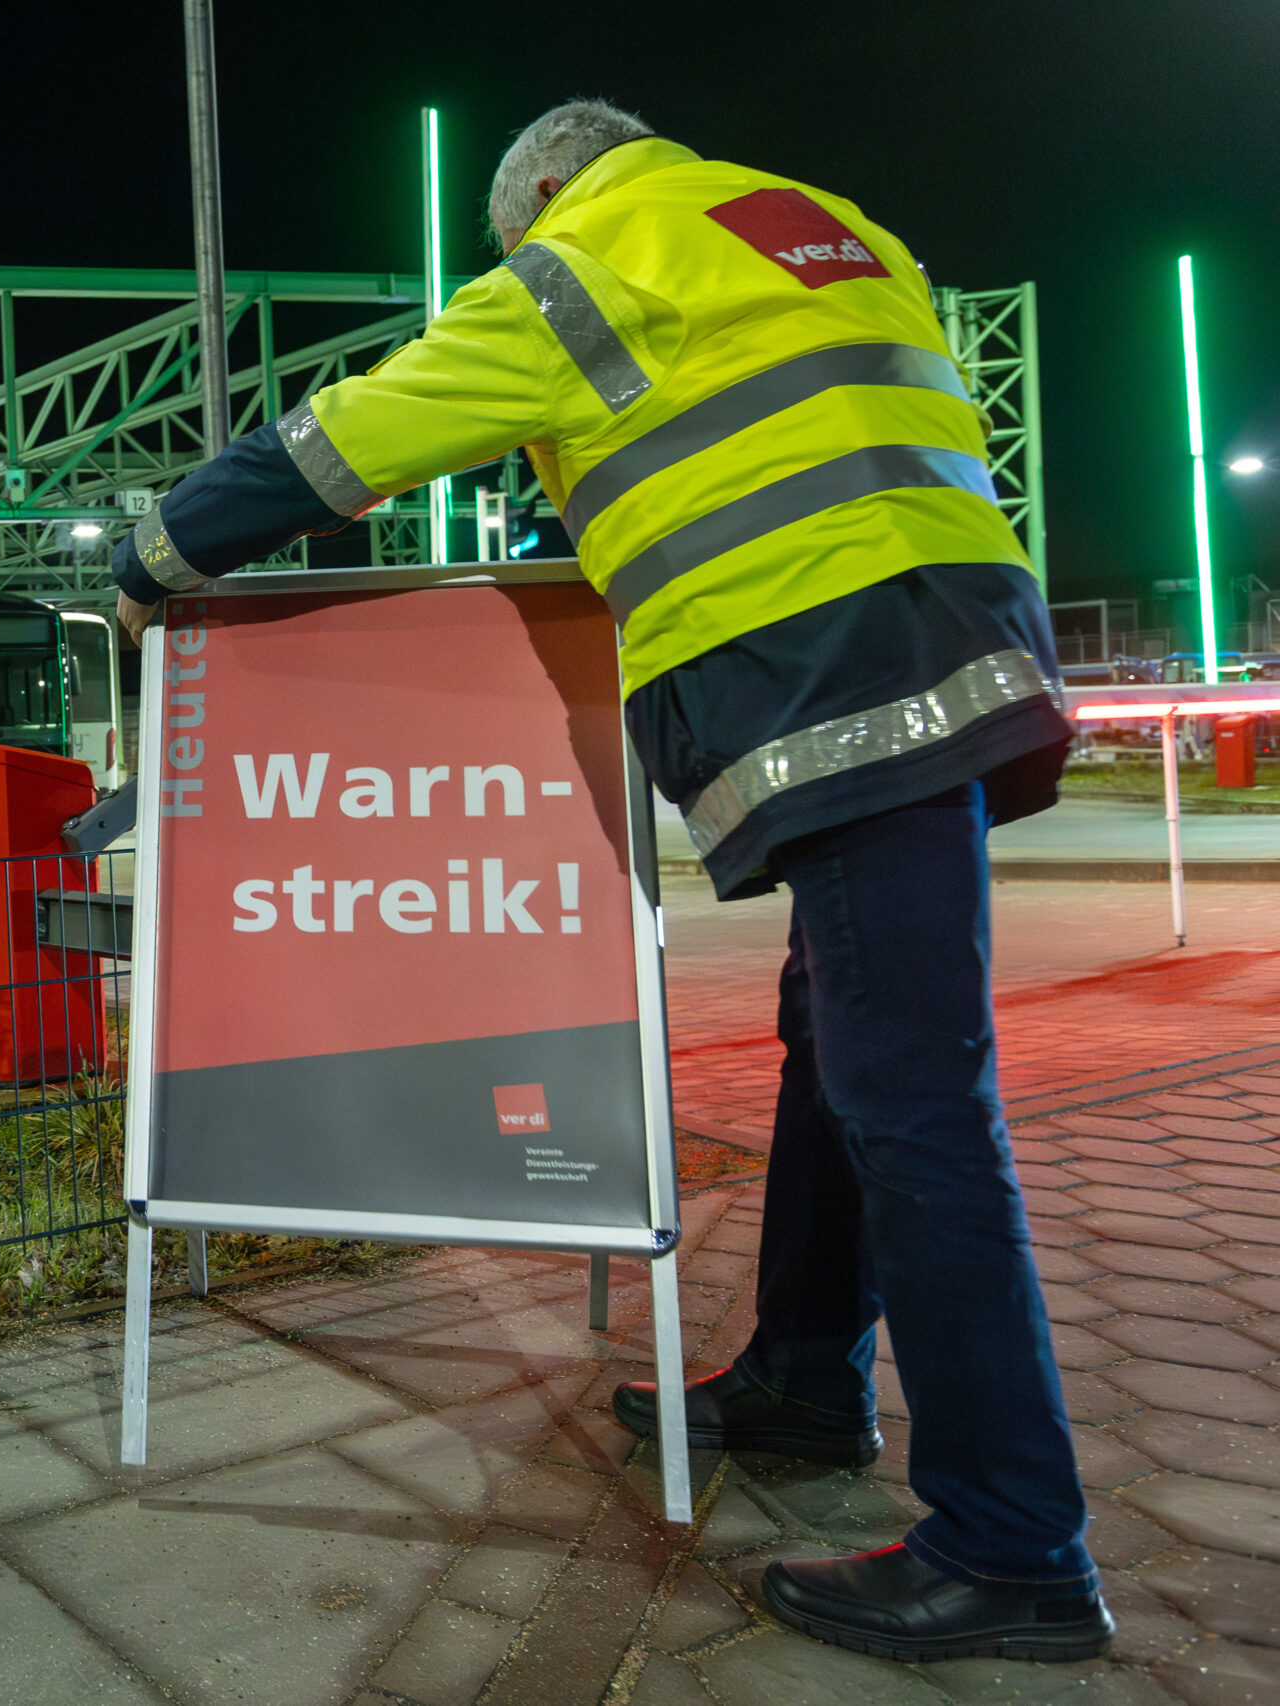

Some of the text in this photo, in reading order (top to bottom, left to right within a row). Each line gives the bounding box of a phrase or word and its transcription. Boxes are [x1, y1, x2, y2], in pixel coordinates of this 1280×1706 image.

[775, 238, 874, 265] ver.di
[133, 496, 145, 511] 12
[162, 602, 207, 817] Heute:
[233, 752, 572, 819] Warn-
[233, 858, 582, 934] streik!
